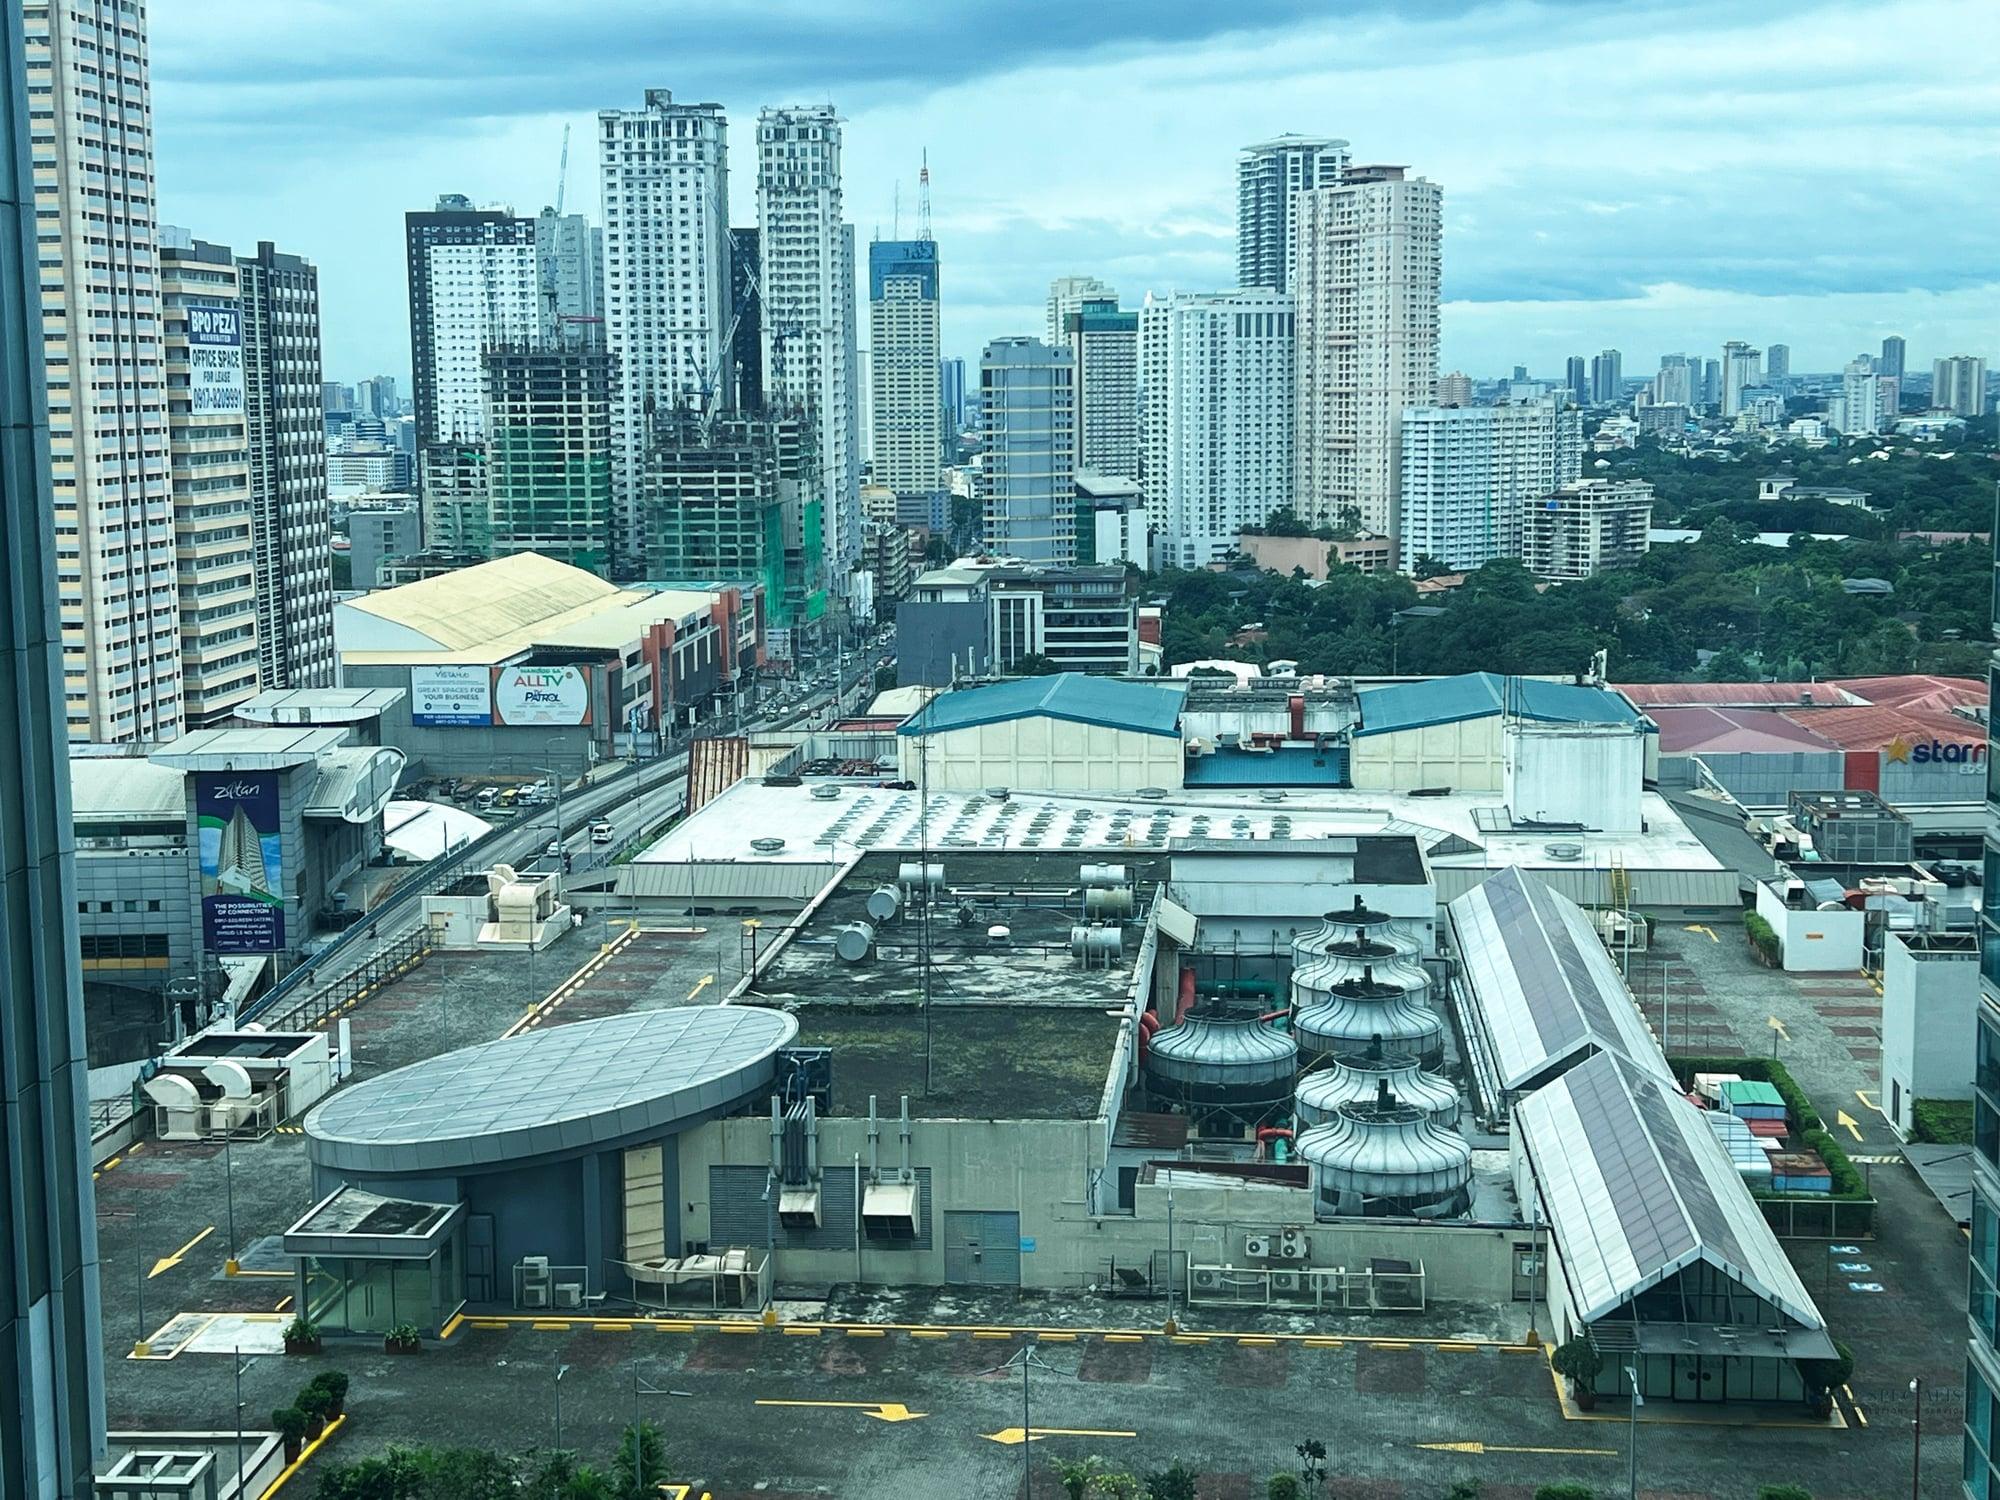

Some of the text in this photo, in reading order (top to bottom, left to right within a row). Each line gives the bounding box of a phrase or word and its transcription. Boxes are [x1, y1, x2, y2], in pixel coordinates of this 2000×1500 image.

[191, 310, 237, 335] BPO PEZA
[192, 349, 240, 369] OFFICE SPACE
[203, 370, 231, 383] FOR LEASE
[514, 675, 564, 687] ALLTV
[524, 692, 561, 702] PATROL
[1960, 764, 1987, 774] EDS
